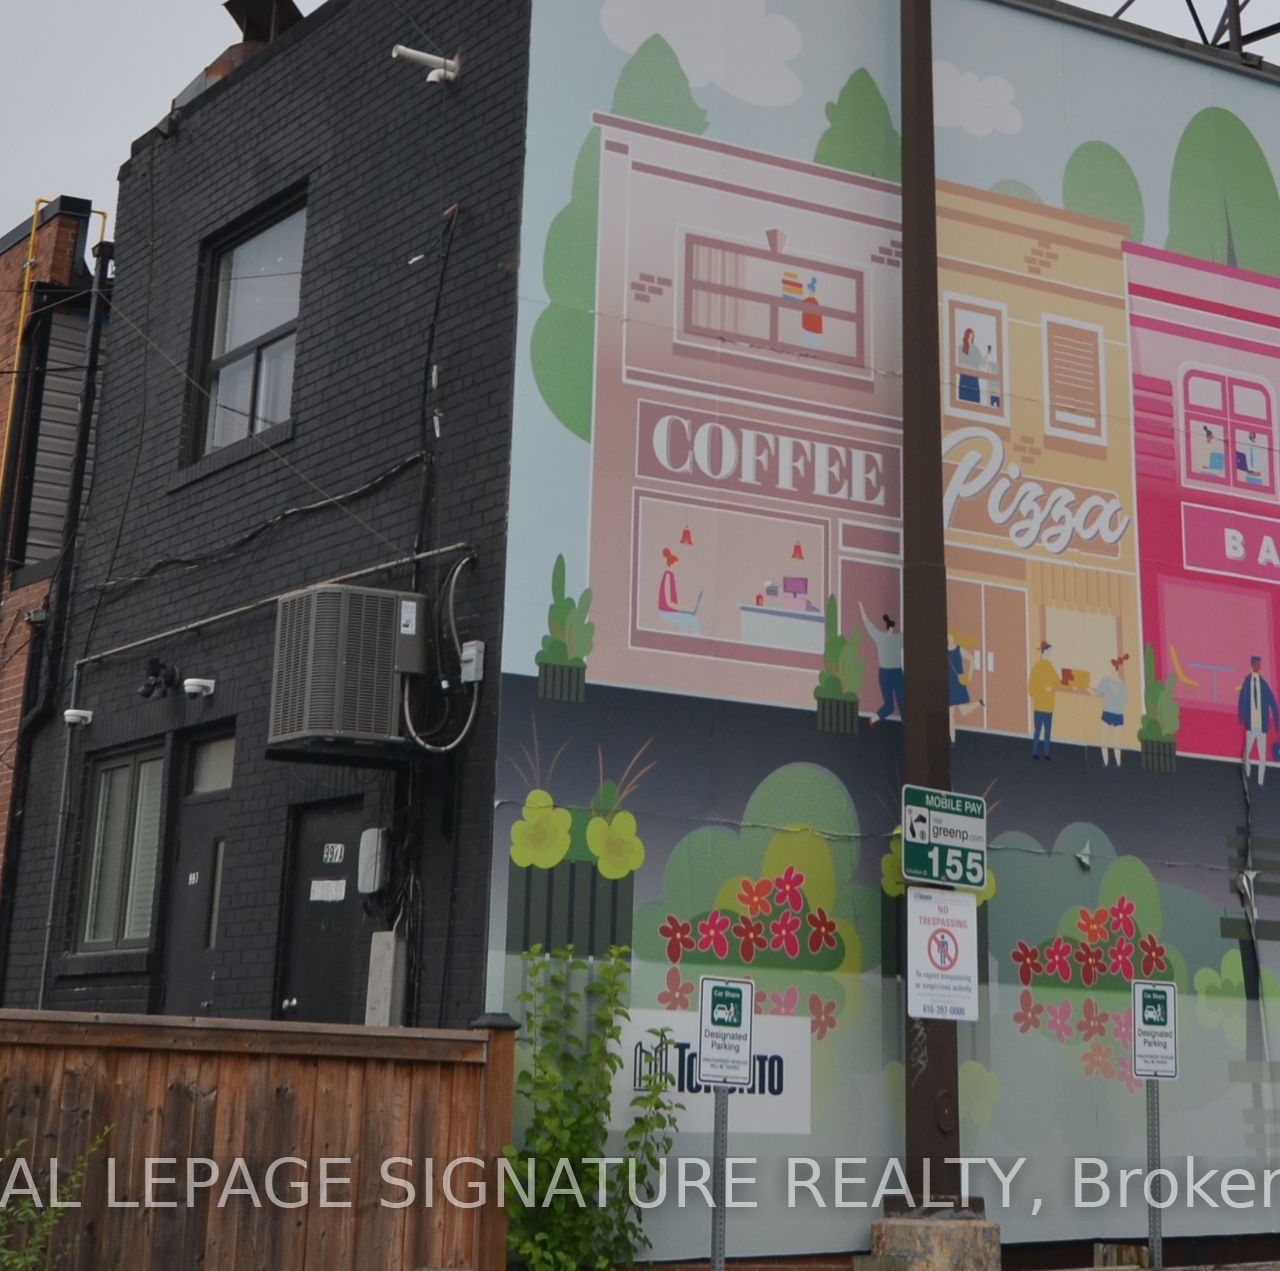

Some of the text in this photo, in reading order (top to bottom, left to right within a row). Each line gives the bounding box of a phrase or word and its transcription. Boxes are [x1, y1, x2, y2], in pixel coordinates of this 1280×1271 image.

[651, 414, 886, 507] COFFEE
[942, 426, 1130, 554] Pizza
[925, 794, 983, 815] MOBILE PAY
[927, 846, 984, 883] 155
[937, 906, 949, 915] NO
[918, 916, 968, 929] TRESPASSING
[713, 989, 741, 998] Car Share
[704, 1029, 748, 1041] Designated
[1138, 1029, 1173, 1039] Designated
[711, 1041, 740, 1053] Parking
[1144, 1039, 1167, 1049] Parking
[674, 1042, 784, 1095] TOTO
